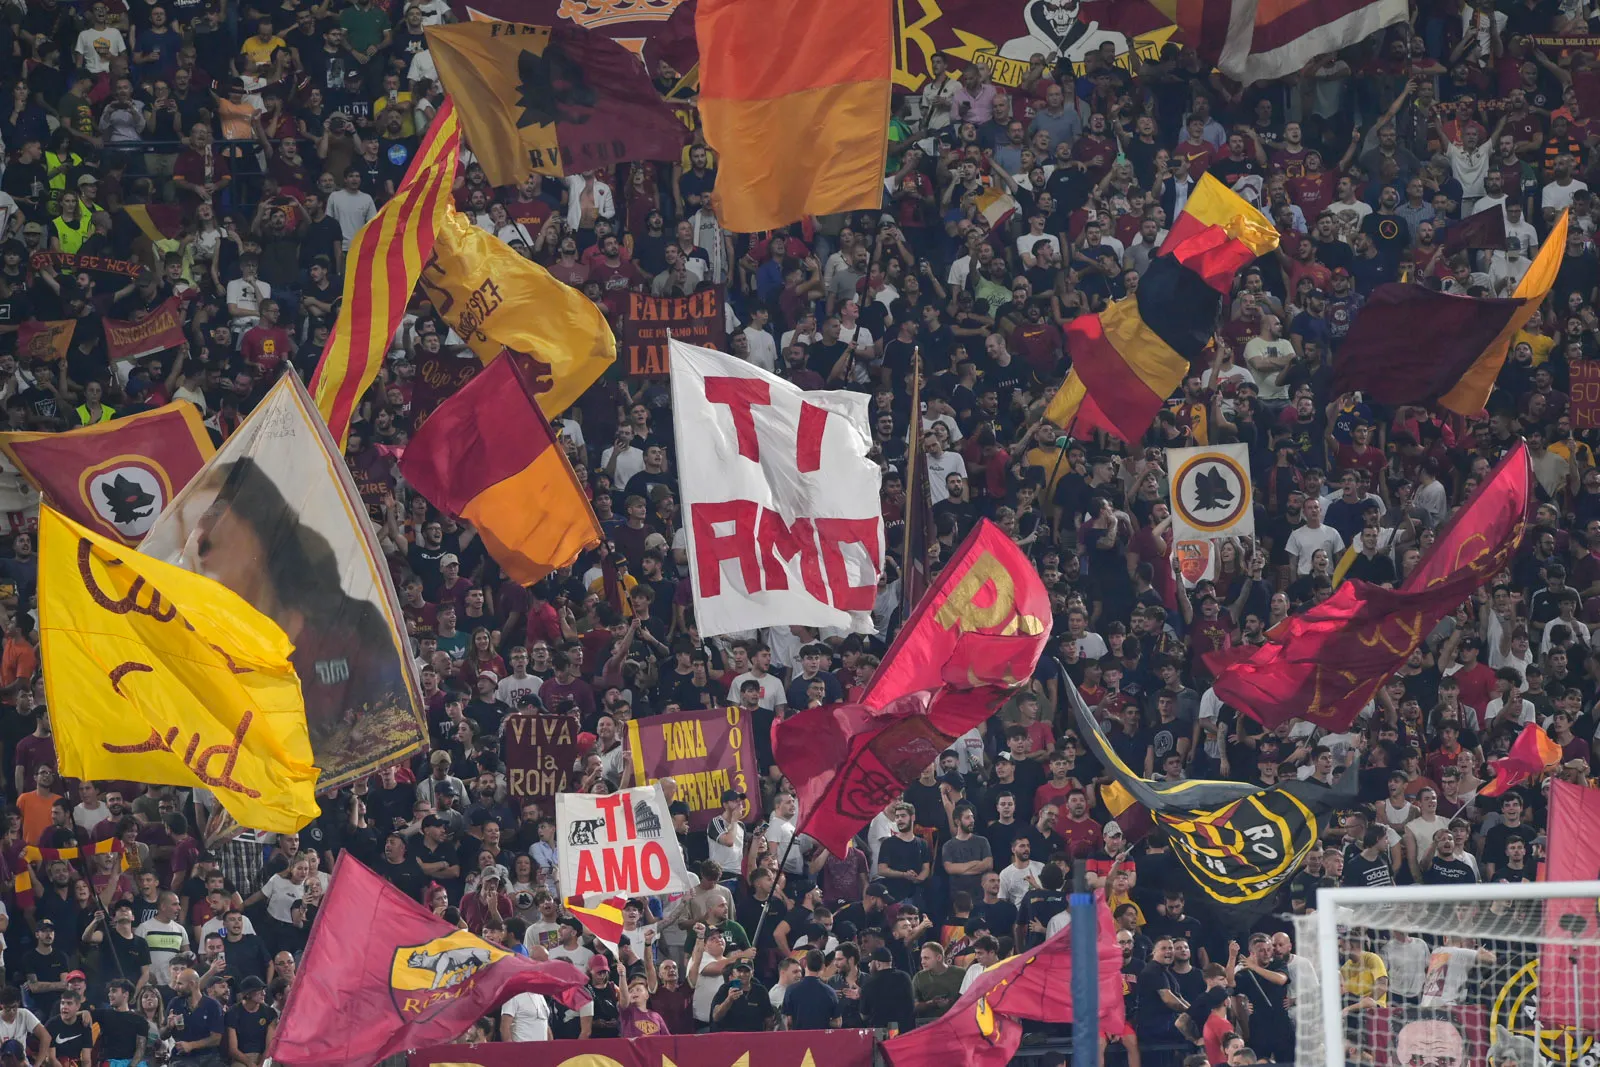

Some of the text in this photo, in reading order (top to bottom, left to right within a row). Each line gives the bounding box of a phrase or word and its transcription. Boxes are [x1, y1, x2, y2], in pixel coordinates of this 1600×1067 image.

[629, 290, 717, 321] FATECE
[638, 328, 654, 338] CHE
[655, 327, 692, 338] PASAMO
[703, 375, 829, 474] TI
[886, 519, 905, 529] QATA
[690, 498, 884, 614] AMO
[511, 718, 571, 745] VIVA
[663, 718, 707, 762] ZONA
[510, 769, 566, 796] ROMA
[595, 793, 637, 843] TI
[575, 840, 672, 896] AMO
